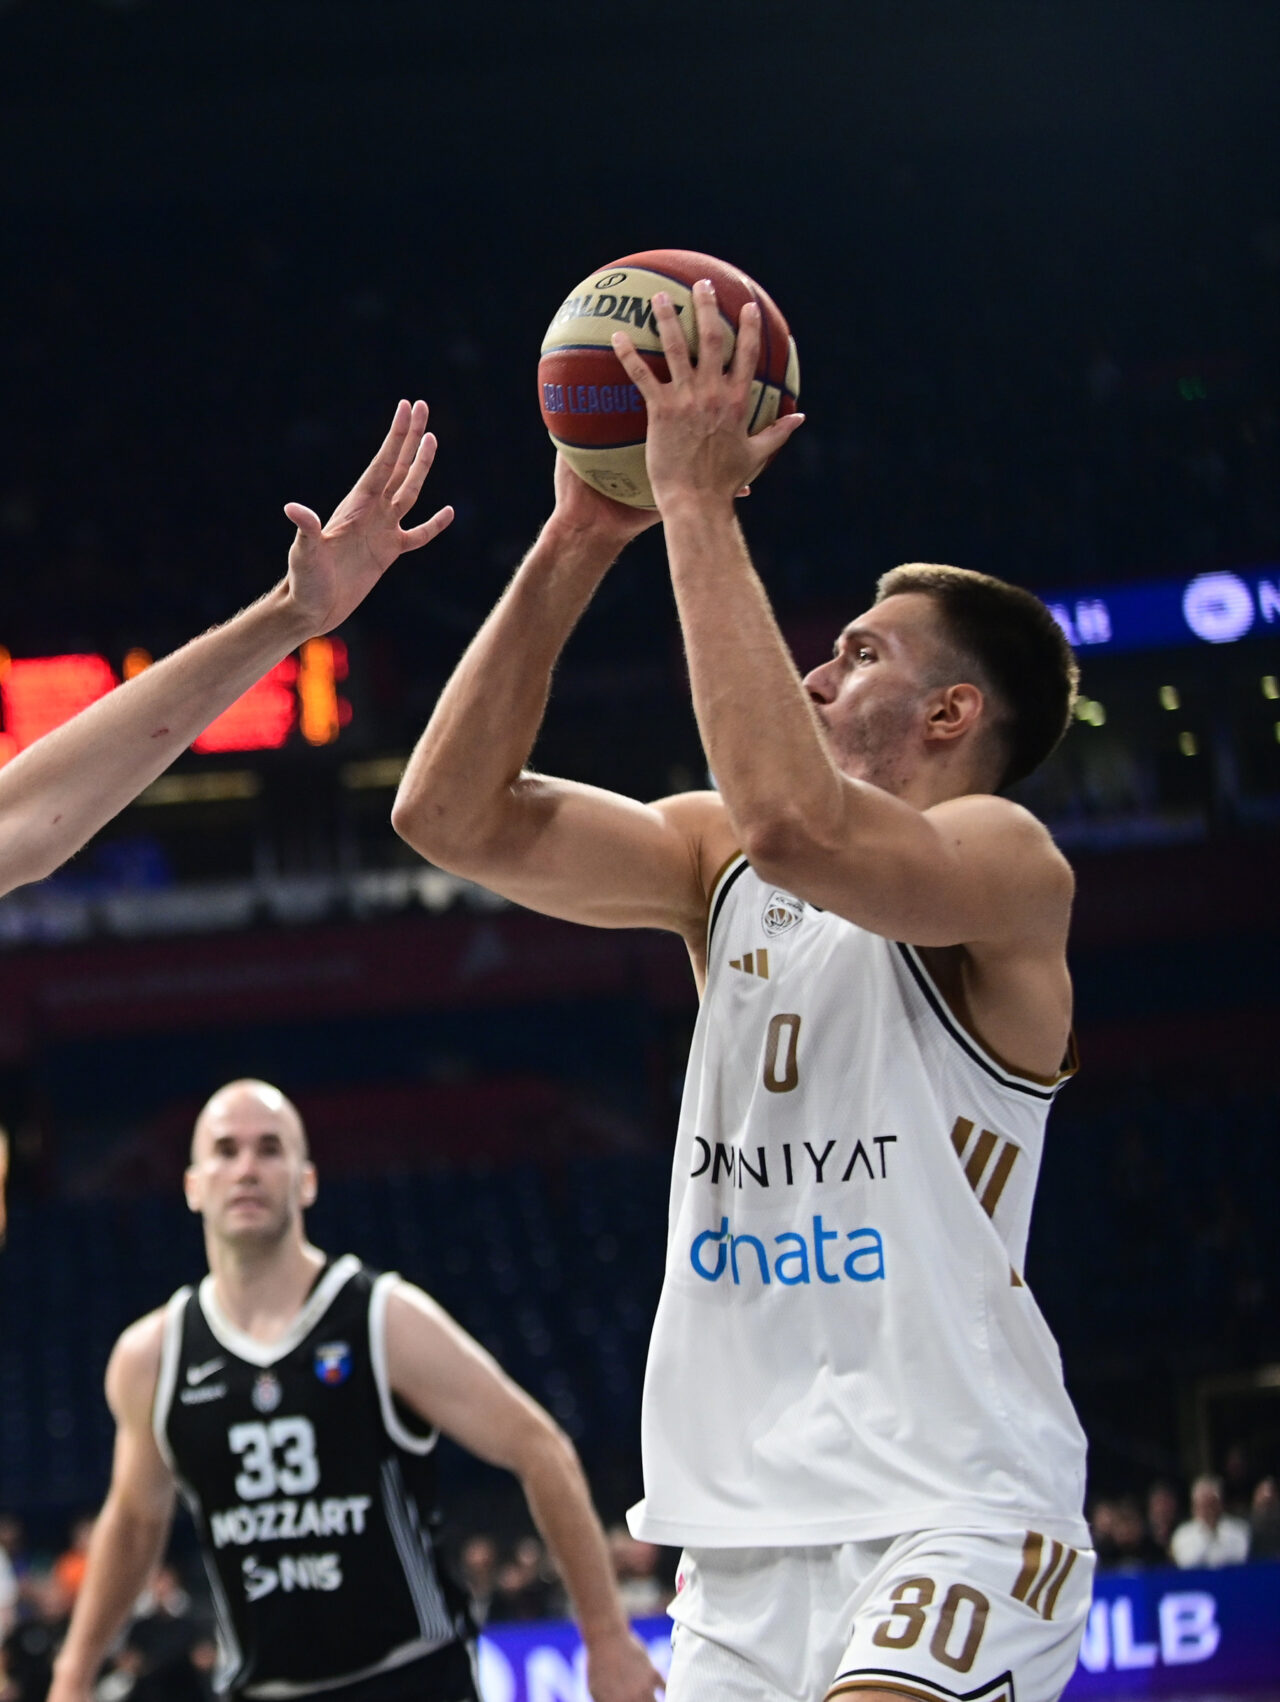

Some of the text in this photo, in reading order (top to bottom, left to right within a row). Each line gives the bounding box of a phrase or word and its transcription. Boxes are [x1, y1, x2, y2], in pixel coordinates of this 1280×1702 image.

[568, 384, 643, 414] LEAGUE
[763, 1013, 802, 1093] 0
[689, 1215, 886, 1286] dnata
[228, 1415, 321, 1501] 33
[210, 1495, 371, 1548] MOZZART
[872, 1577, 989, 1673] 30
